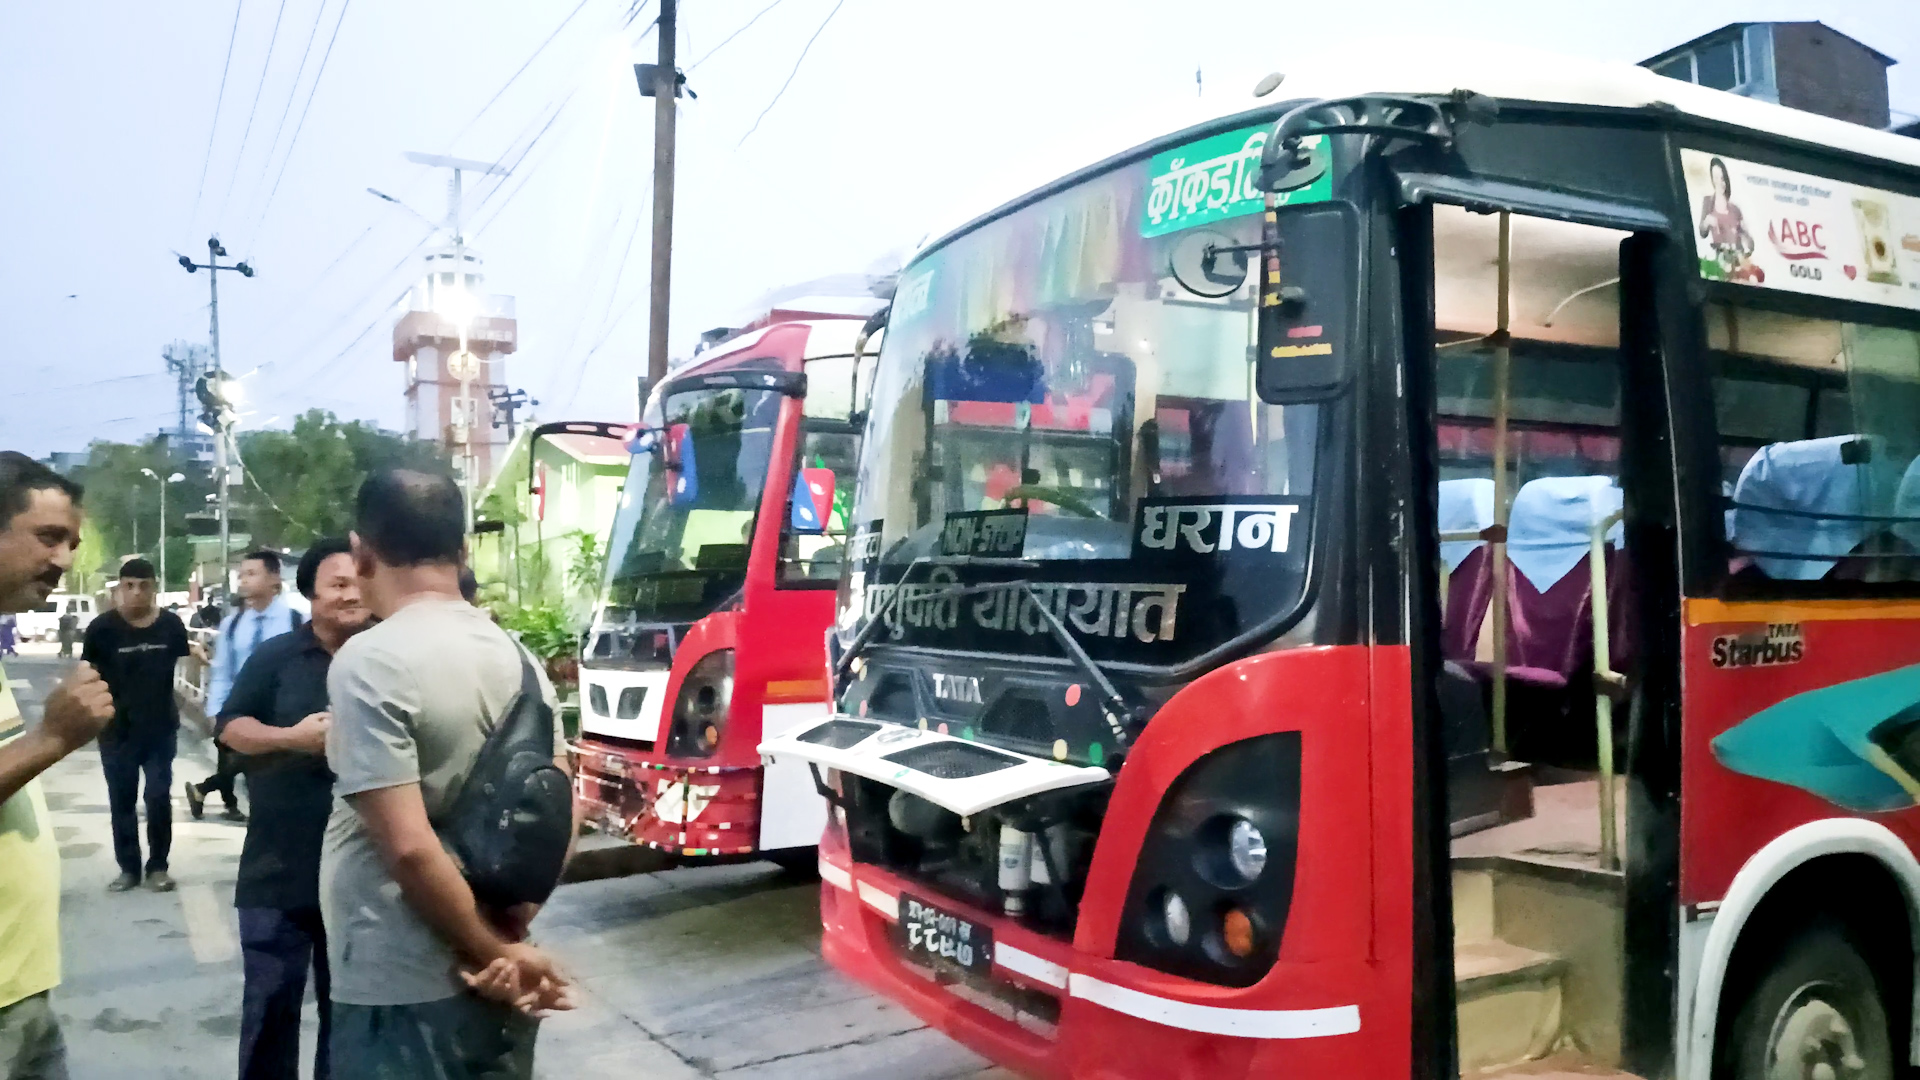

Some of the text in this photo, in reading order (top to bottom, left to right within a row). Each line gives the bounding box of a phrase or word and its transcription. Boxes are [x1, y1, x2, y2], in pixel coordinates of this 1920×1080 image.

[1781, 218, 1827, 250] ABC
[1790, 264, 1822, 281] GOLD
[973, 582, 1187, 643] यातायात
[1712, 637, 1803, 667] Starbus
[932, 672, 984, 704] TATA
